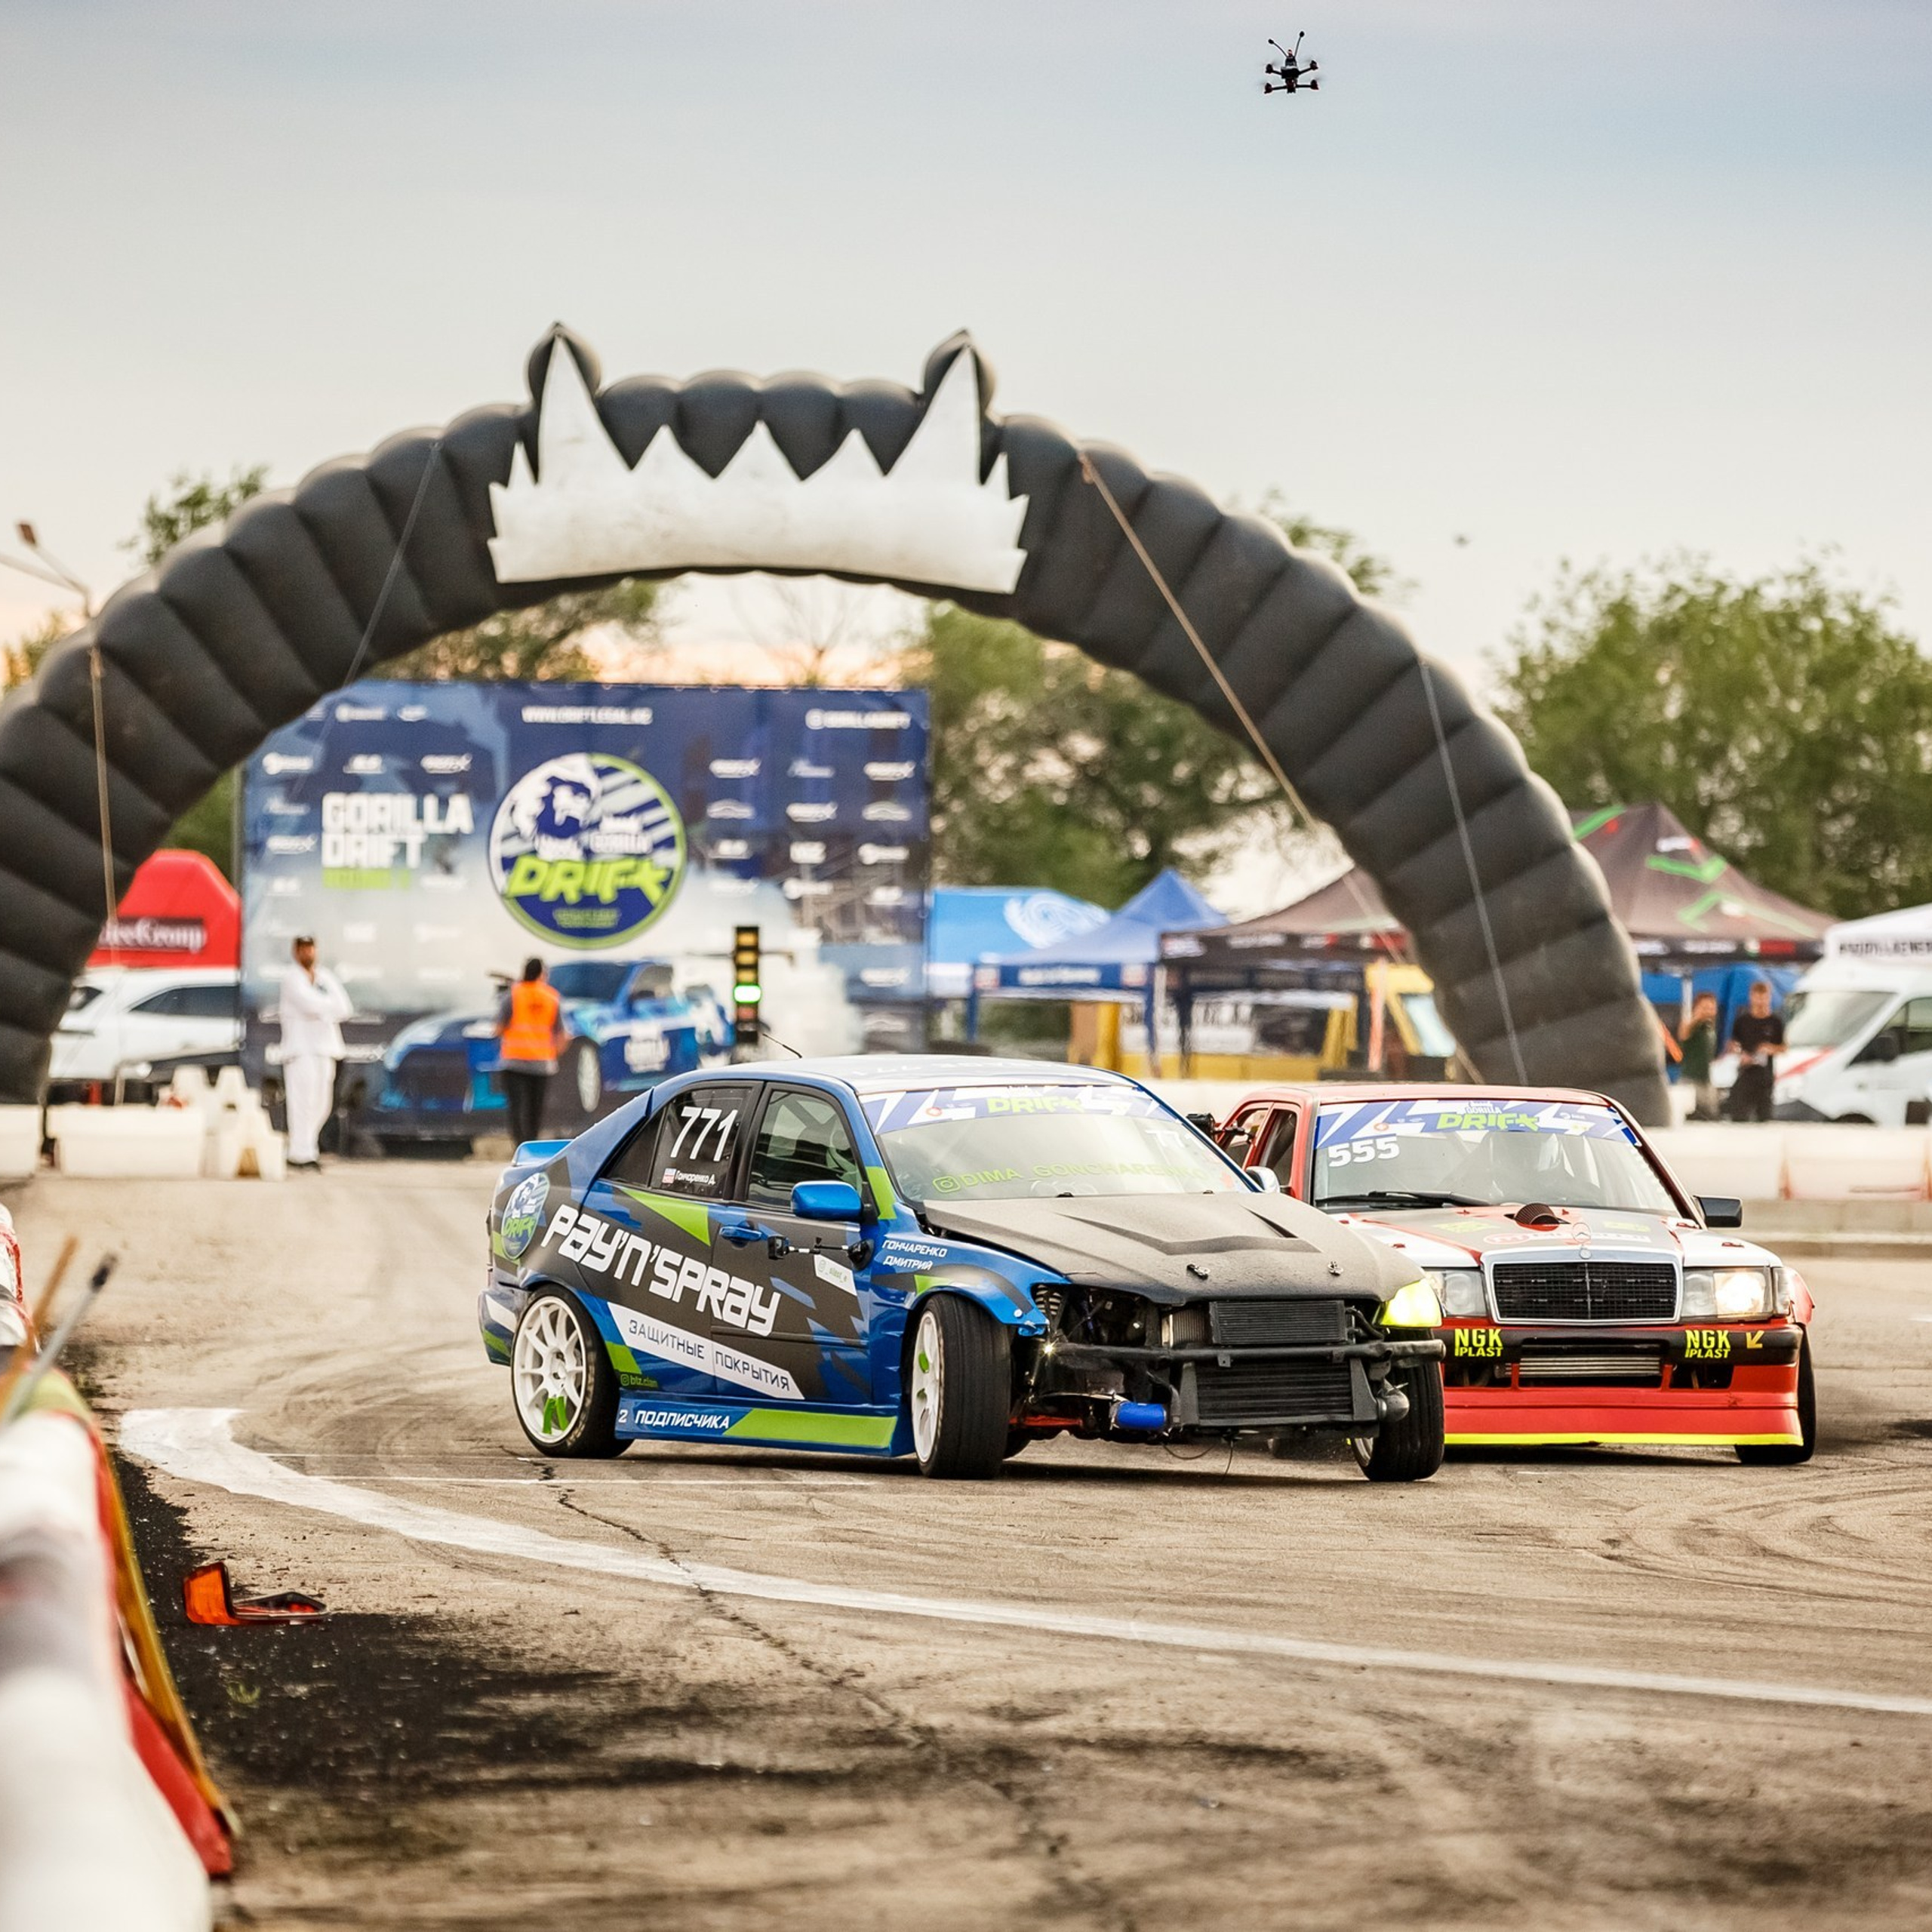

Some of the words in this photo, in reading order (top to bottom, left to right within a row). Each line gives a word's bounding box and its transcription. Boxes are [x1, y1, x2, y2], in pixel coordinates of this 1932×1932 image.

[322, 792, 474, 834] GORILLA
[322, 832, 428, 869] DRIFT
[506, 855, 668, 906] DRIFT
[986, 1096, 1086, 1114] DRIFT
[1436, 1112, 1540, 1132] DRIFT
[670, 1106, 738, 1161] 771
[1327, 1135, 1400, 1167] 555
[503, 1216, 536, 1238] DRIFT
[881, 1240, 947, 1257] ГОНЧАРЕНКО
[882, 1255, 933, 1270] ДМИТРИЙ
[1454, 1328, 1503, 1348] NGK
[1685, 1330, 1731, 1349] NGK
[629, 1319, 705, 1359] ЗАЩИТНЫЕ
[715, 1351, 789, 1391] ПОКРЫТИЯ
[618, 1409, 629, 1423] 2
[635, 1410, 731, 1429] ПОДПИСЧИКА
